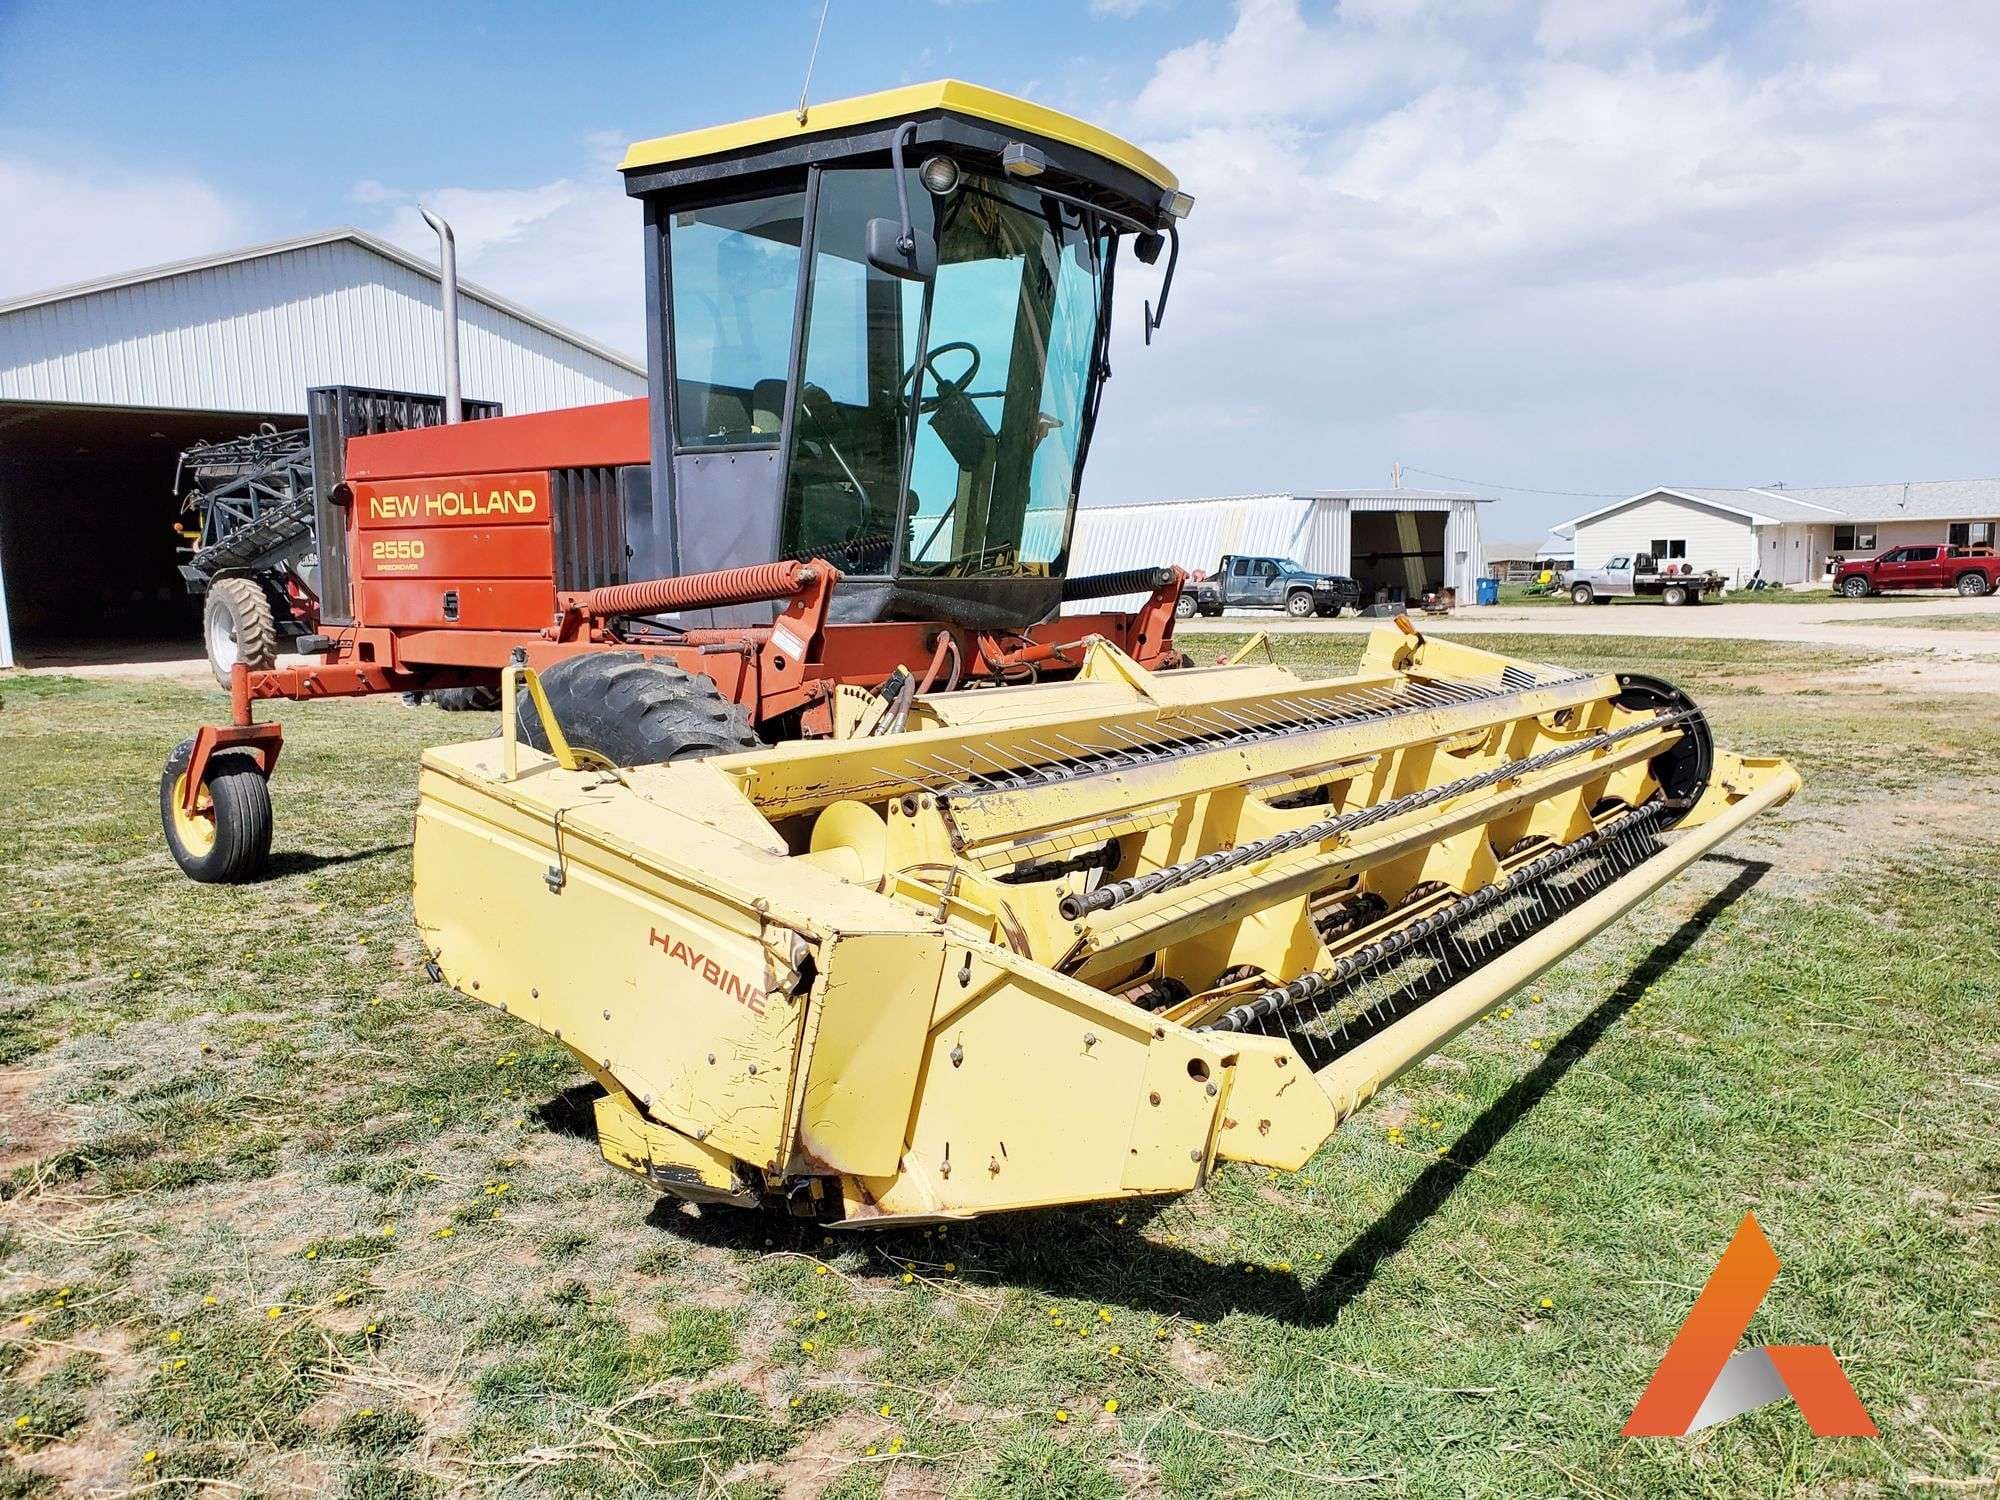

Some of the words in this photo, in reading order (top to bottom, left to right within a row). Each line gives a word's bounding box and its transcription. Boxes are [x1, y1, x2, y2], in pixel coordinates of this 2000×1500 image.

[370, 495, 419, 519] NEW
[425, 489, 536, 516] HOLLAND
[372, 540, 425, 560] 2550
[649, 927, 768, 1016] HAYBINE
